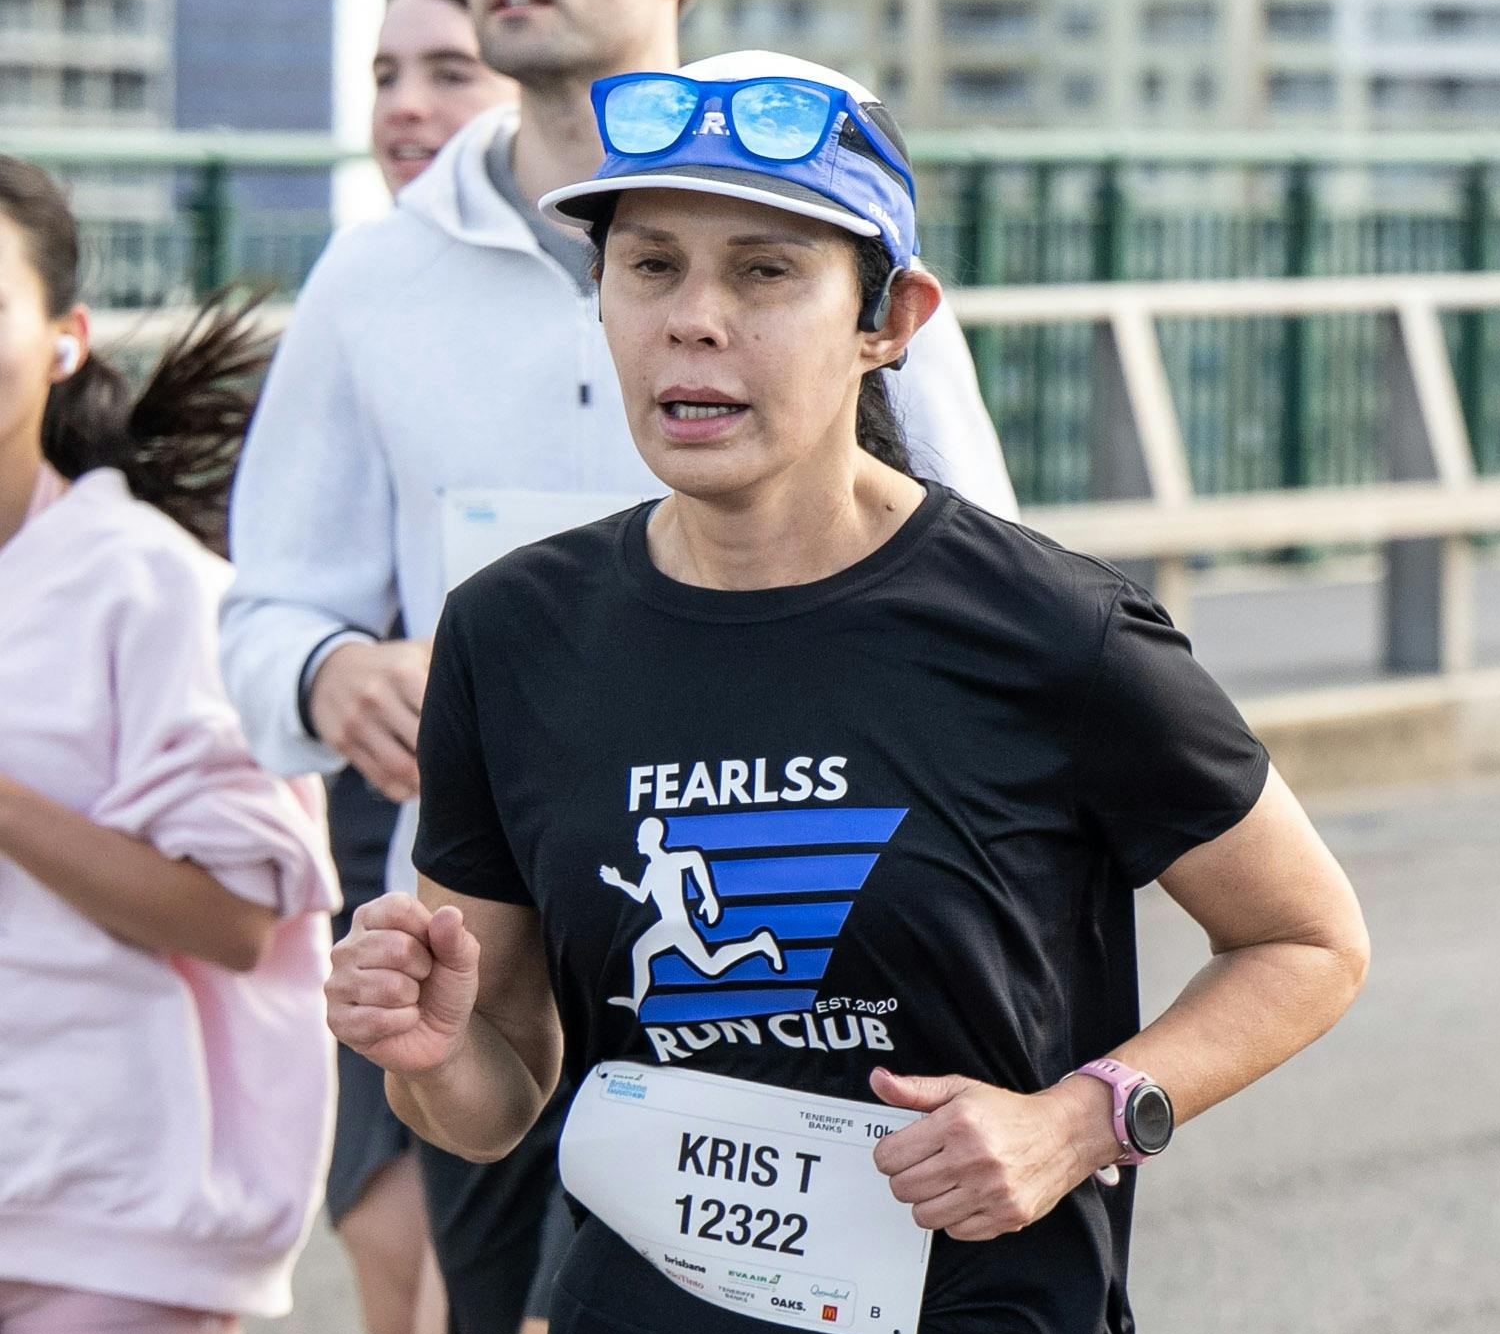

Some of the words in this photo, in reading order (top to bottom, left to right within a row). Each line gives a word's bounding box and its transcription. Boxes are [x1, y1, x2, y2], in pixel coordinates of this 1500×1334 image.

[628, 756, 848, 812] FEARLSS
[816, 997, 898, 1014] EST.2020
[645, 1020, 762, 1063] RUN
[768, 1013, 895, 1053] CLUB
[800, 1111, 854, 1128] TENERIFFE
[864, 1123, 894, 1139] 10k
[808, 1121, 842, 1134] BANKS
[677, 1131, 780, 1189] KRIS
[794, 1151, 822, 1195] T
[674, 1193, 809, 1257] 12322
[664, 1254, 706, 1274] brisbane
[870, 1305, 881, 1319] B
